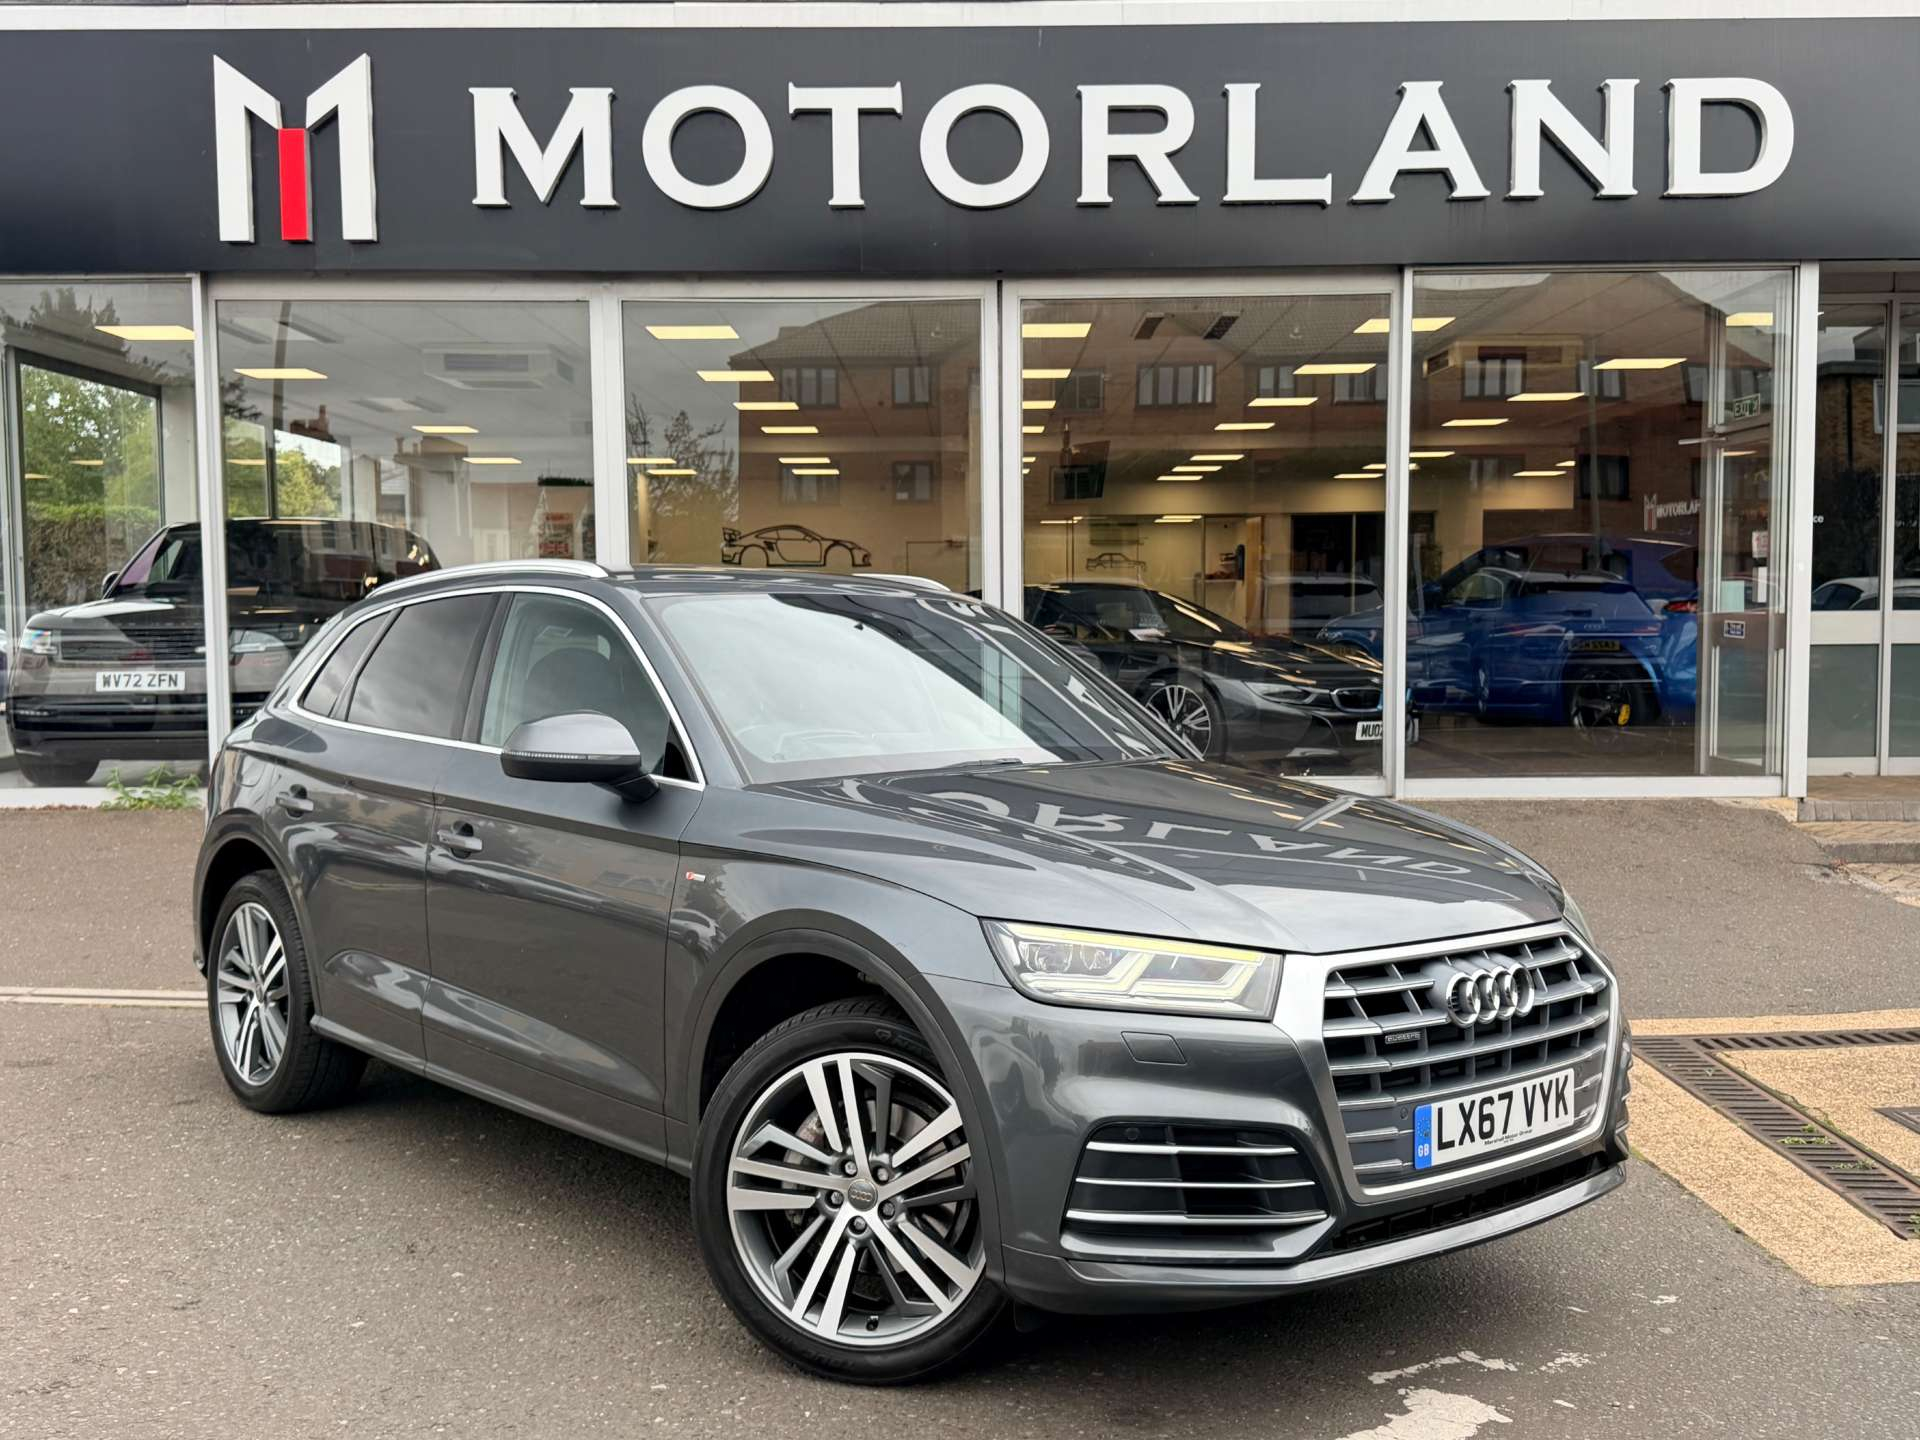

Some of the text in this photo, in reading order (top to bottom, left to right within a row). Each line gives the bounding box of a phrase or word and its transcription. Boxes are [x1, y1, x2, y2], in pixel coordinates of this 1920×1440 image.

[468, 77, 1795, 209] MOTORLAND
[102, 674, 178, 688] WV72 ZFN
[1437, 1074, 1569, 1151] LX67 VYK
[1417, 1143, 1430, 1157] GB
